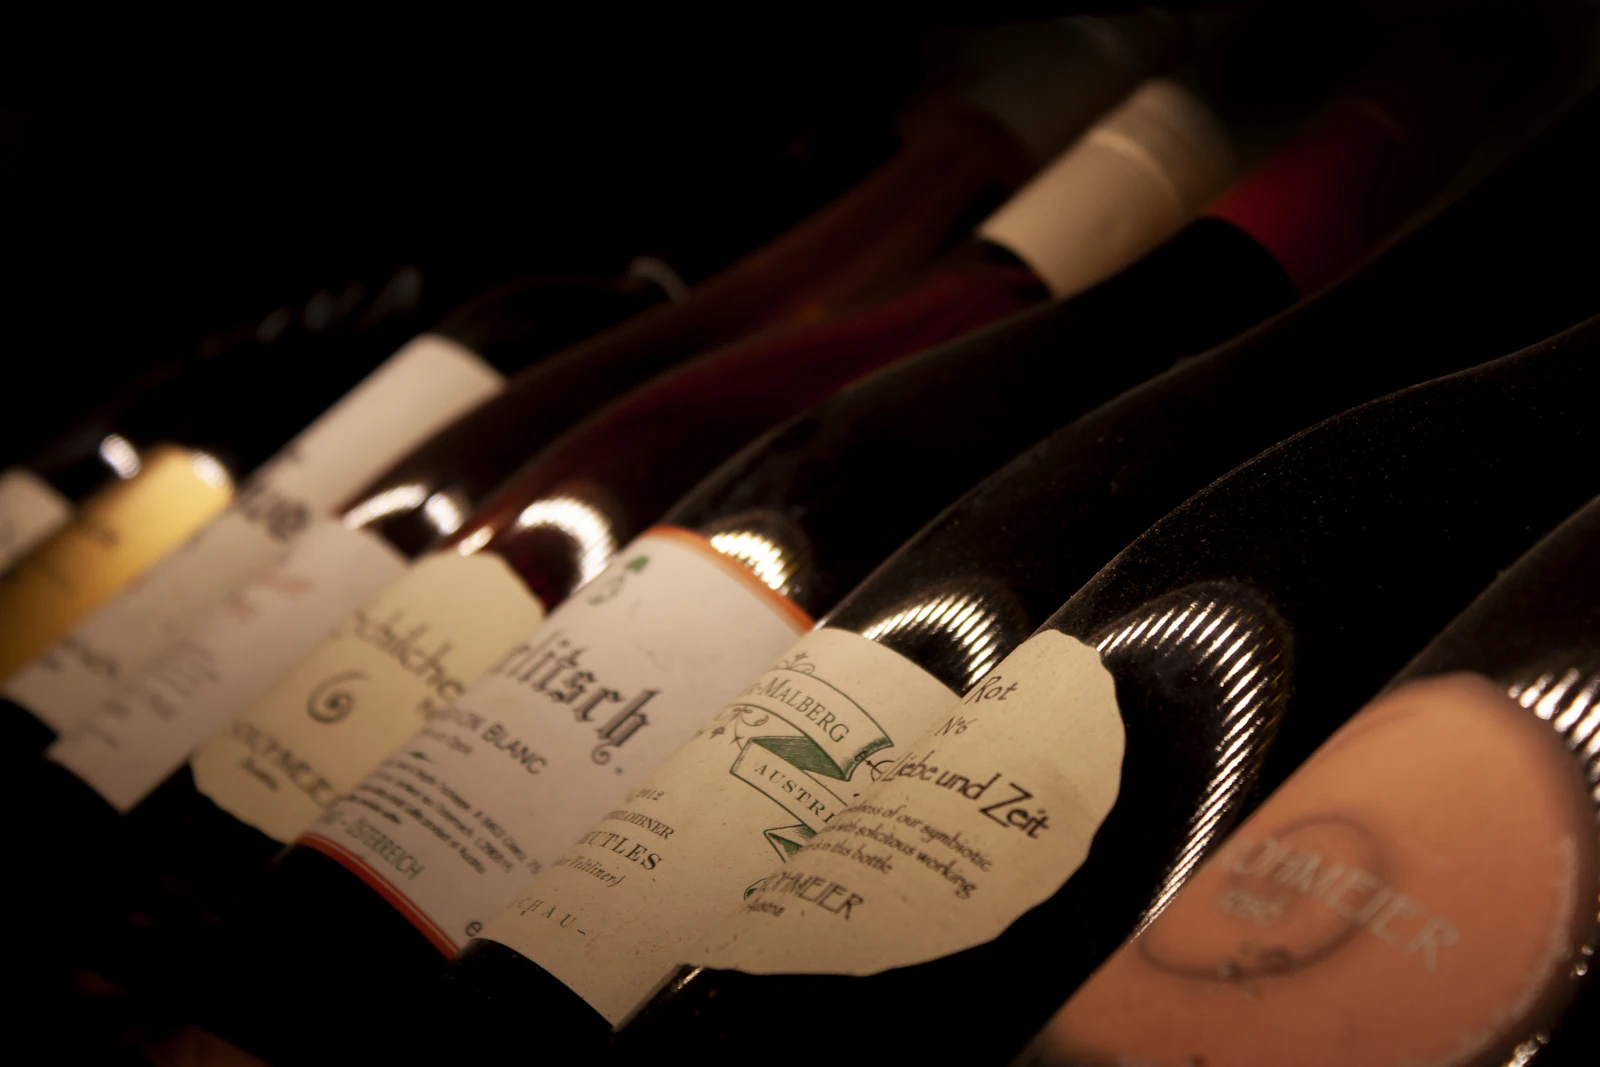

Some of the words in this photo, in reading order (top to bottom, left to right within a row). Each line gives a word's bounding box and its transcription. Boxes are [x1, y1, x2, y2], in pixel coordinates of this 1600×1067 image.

[964, 676, 1018, 705] Rot
[480, 723, 548, 775] BLANC
[935, 772, 1002, 800] und
[979, 782, 1049, 839] Zeit
[851, 844, 893, 875] bottle
[920, 824, 993, 872] symbiotic
[915, 852, 978, 900] working
